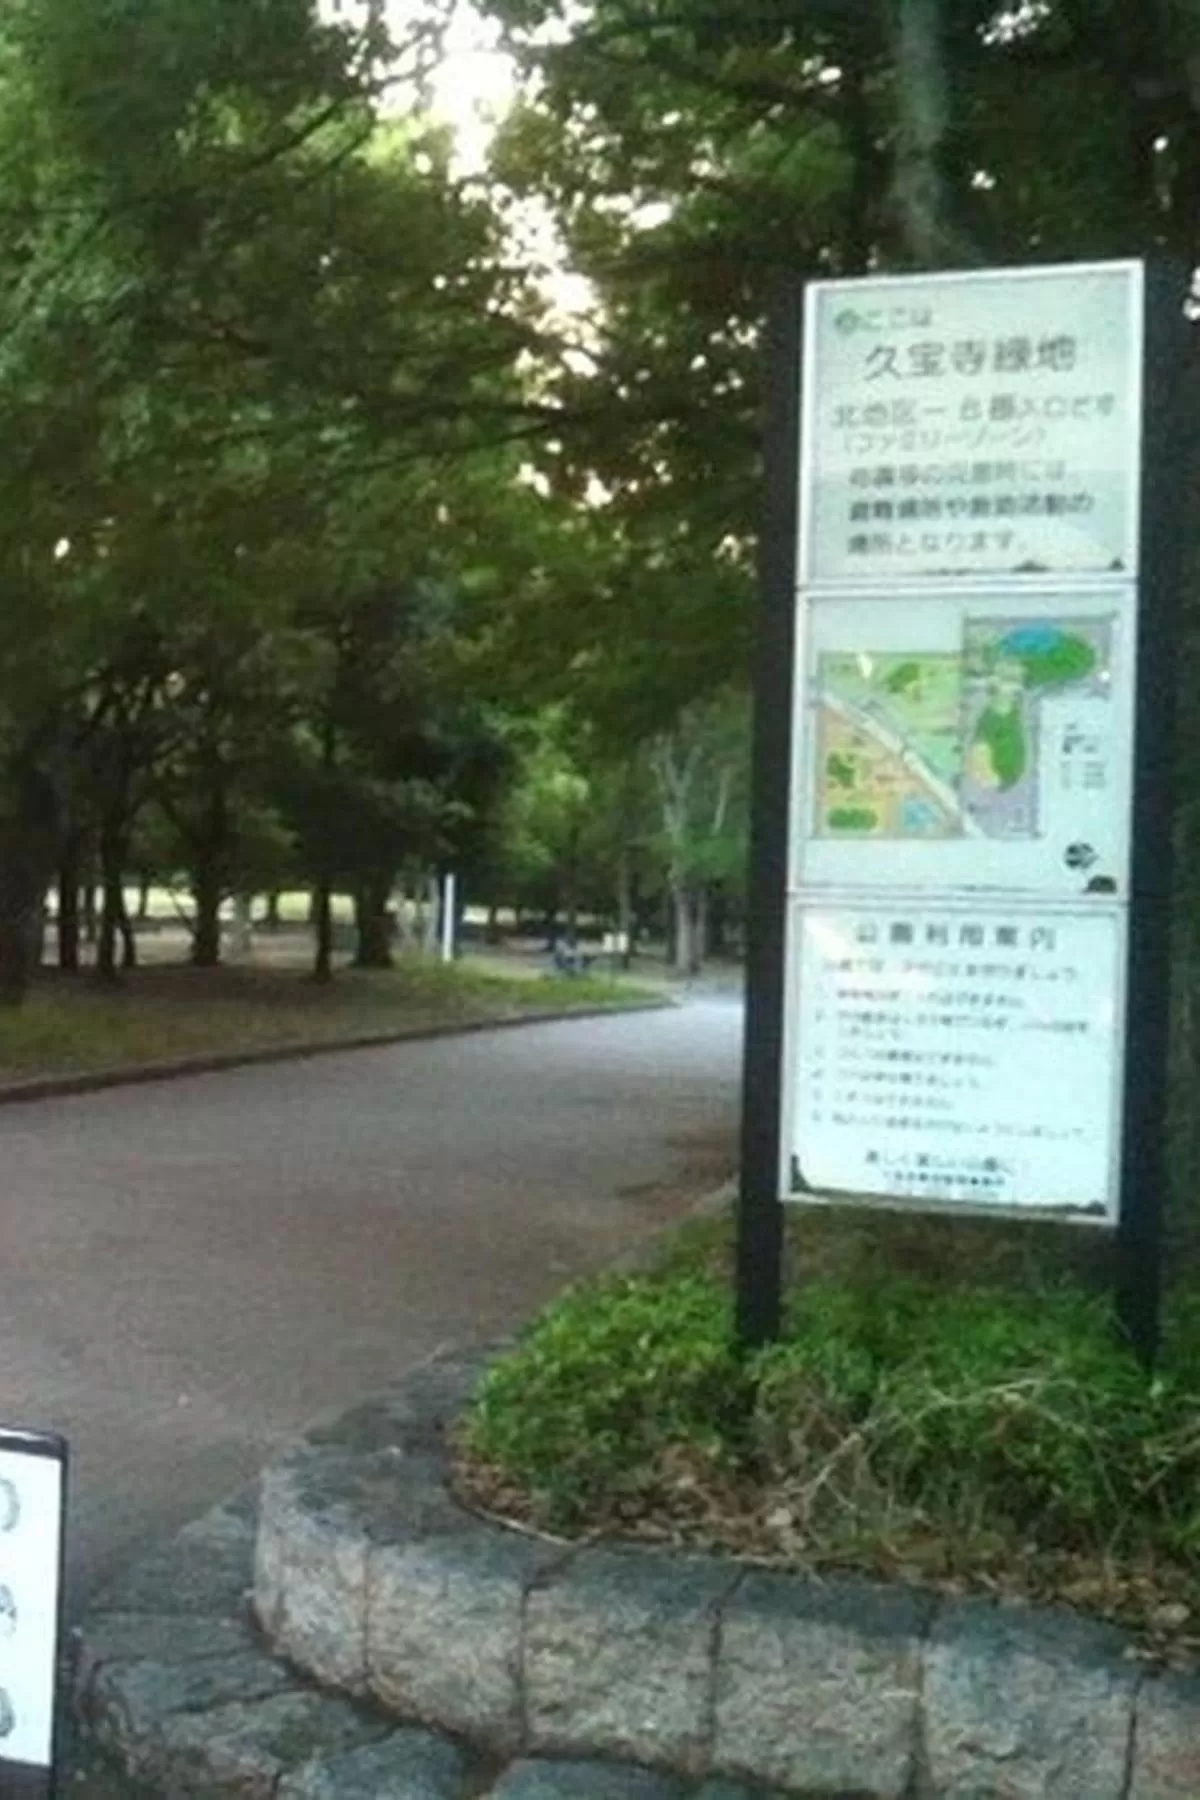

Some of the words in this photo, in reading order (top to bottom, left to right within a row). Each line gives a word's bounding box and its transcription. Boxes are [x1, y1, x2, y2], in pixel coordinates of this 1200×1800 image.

[864, 334, 1079, 382] 久宝寺緑地
